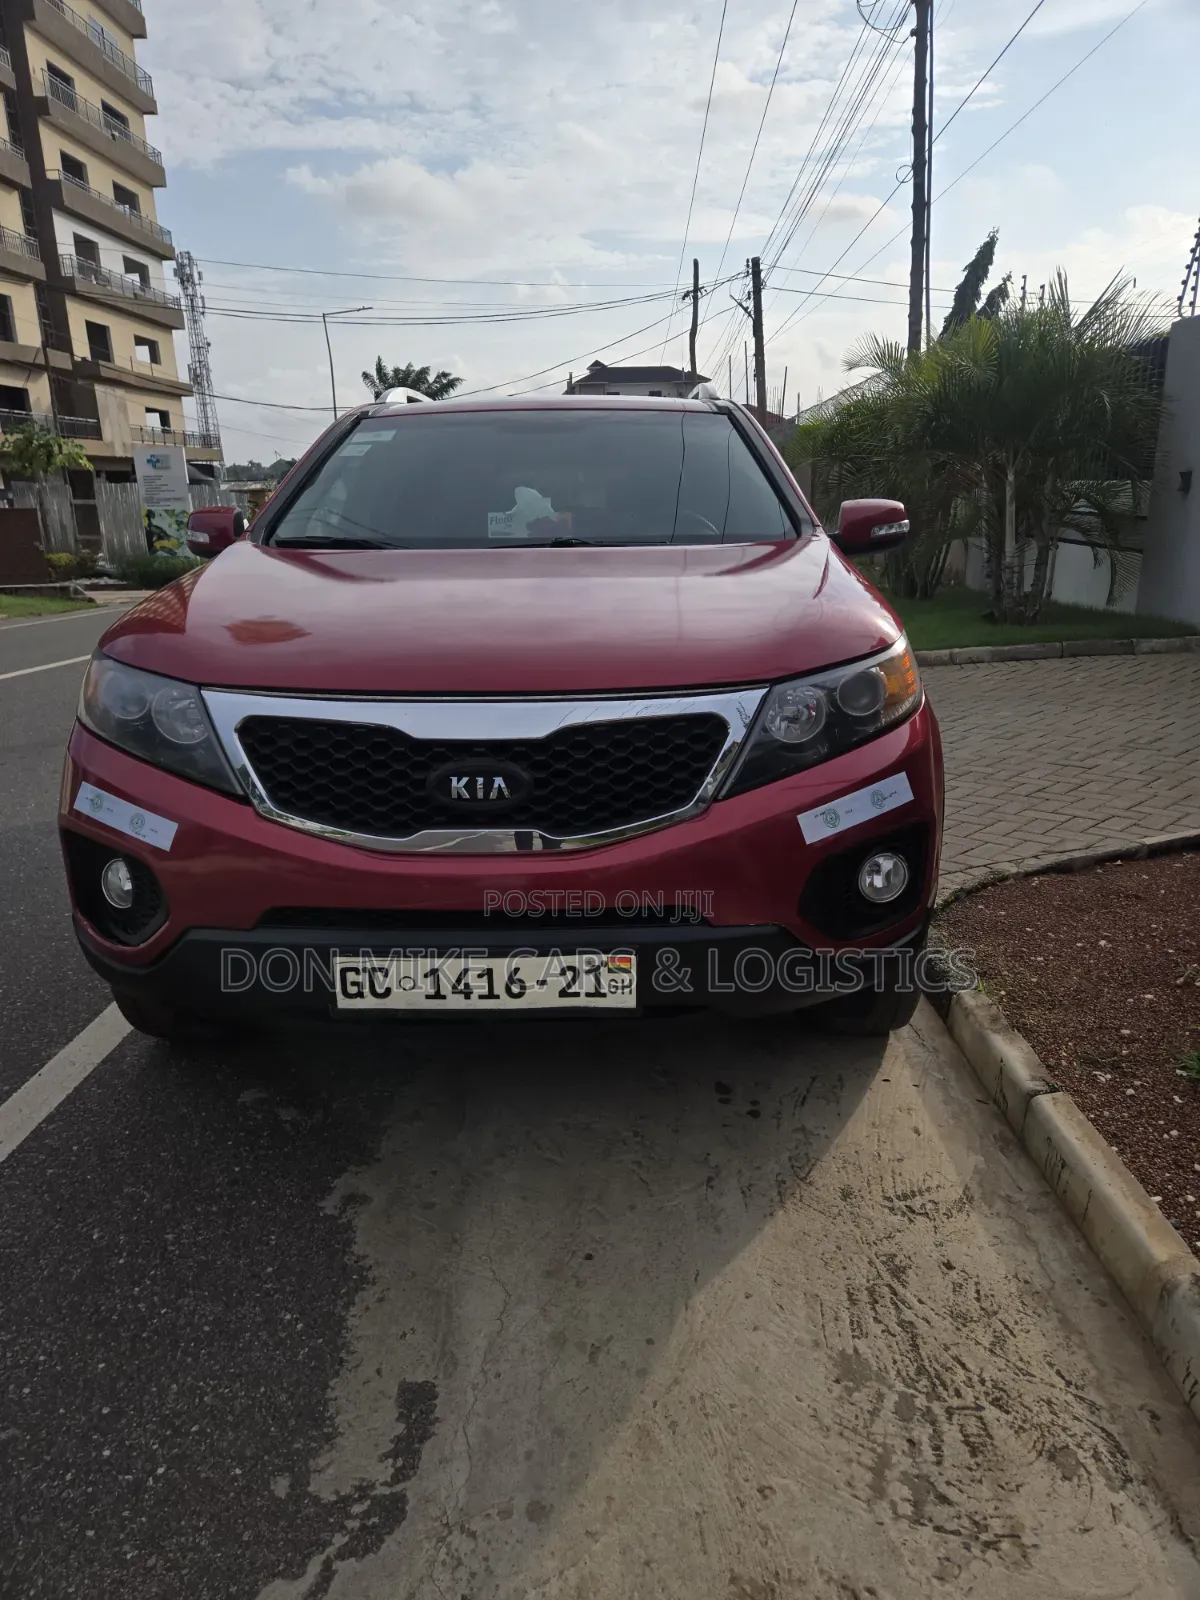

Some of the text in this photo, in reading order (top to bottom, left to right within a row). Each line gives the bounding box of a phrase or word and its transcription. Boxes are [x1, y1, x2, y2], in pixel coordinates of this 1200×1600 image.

[449, 776, 511, 799] KIA
[340, 966, 392, 999] GC
[423, 967, 527, 1000] 1416
[558, 965, 608, 998] 21
[607, 979, 633, 995] GH
